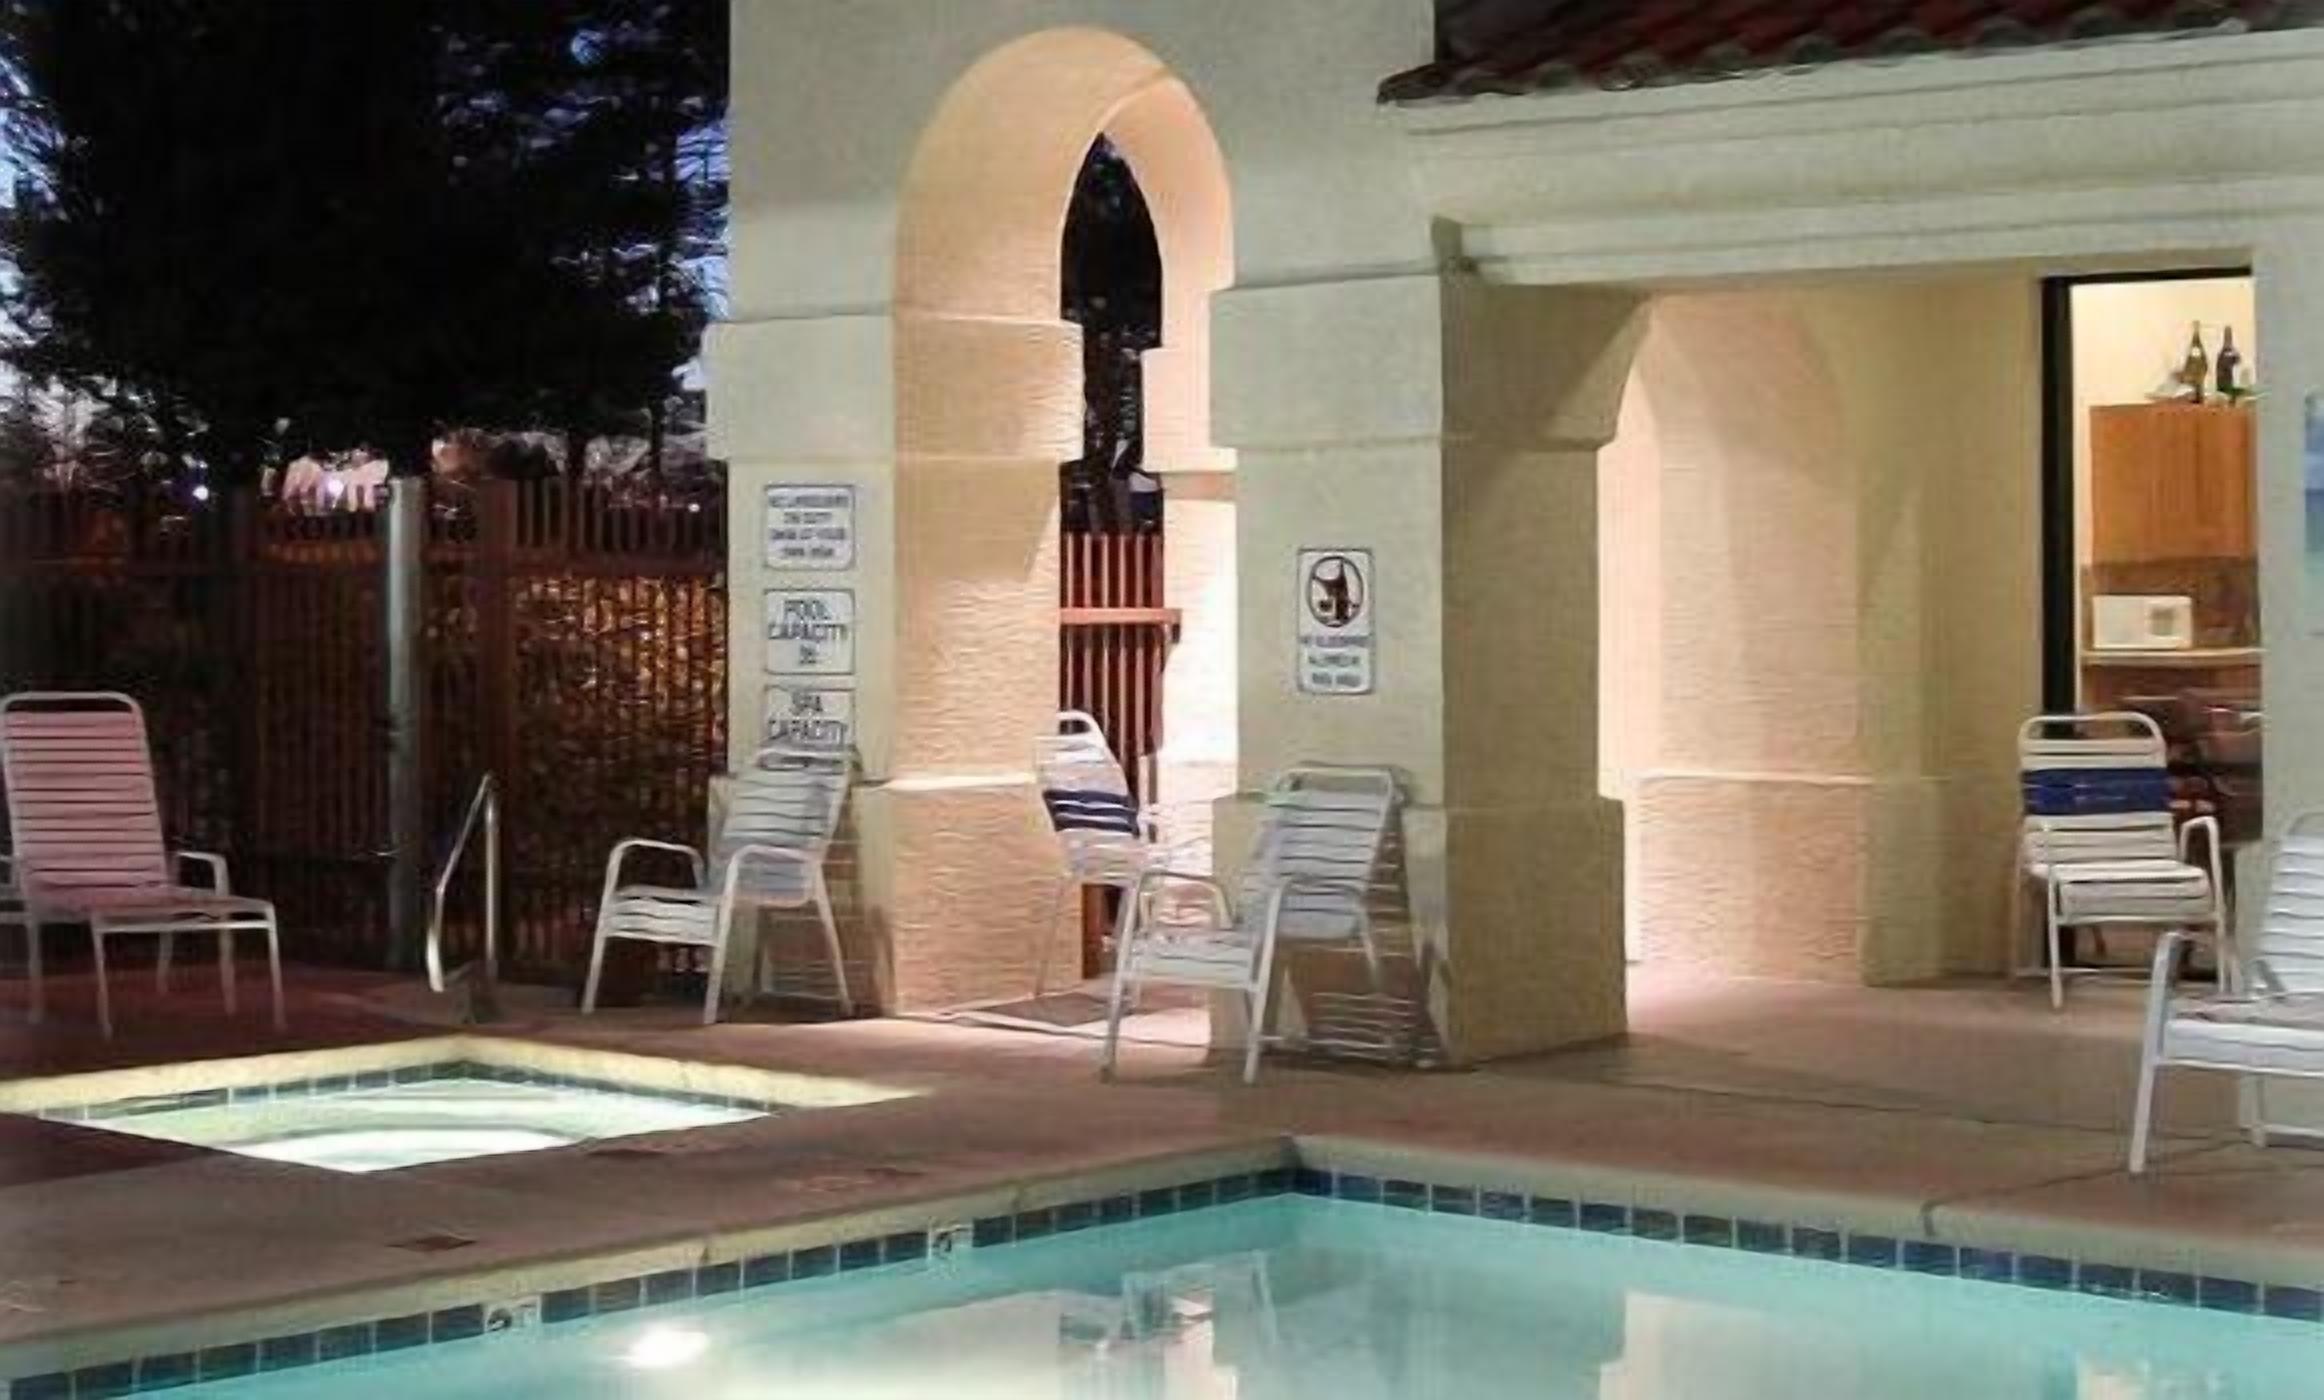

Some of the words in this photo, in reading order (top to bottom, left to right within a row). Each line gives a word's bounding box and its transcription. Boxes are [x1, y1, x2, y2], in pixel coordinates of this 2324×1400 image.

[784, 599, 831, 620] POOL
[768, 623, 847, 640] CAPACITY
[790, 692, 823, 714] SPA
[768, 719, 848, 744] CAPACITY
